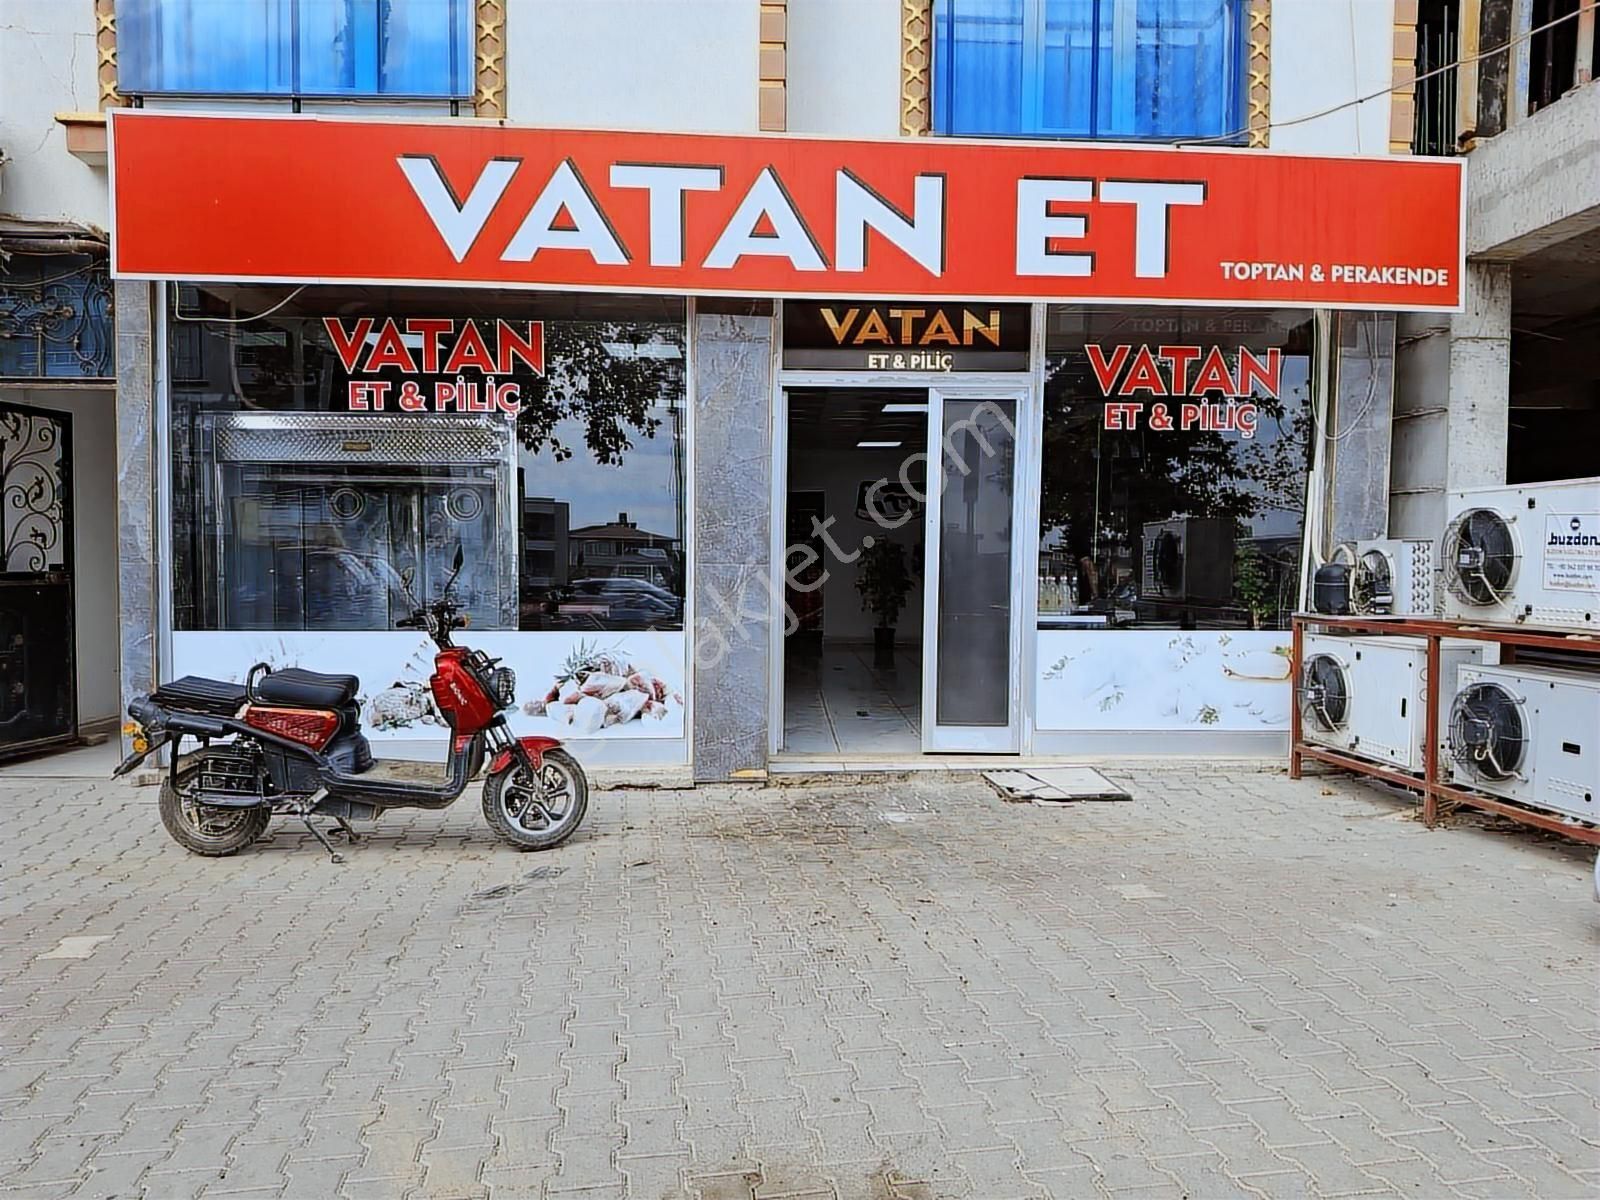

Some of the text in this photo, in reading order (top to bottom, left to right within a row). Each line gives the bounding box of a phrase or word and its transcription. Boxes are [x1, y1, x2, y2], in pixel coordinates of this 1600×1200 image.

[396, 154, 1208, 279] VATAN ET
[1220, 261, 1449, 287] TOPTAN & PERAKENDE
[322, 316, 545, 378] VATAN
[819, 307, 1000, 347] VATAN
[868, 350, 953, 373] ET & PİLİÇ
[1084, 343, 1281, 399] VATAN
[349, 375, 521, 420] ET & PİLİÇ
[1104, 398, 1258, 438] ET & PİLİÇ
